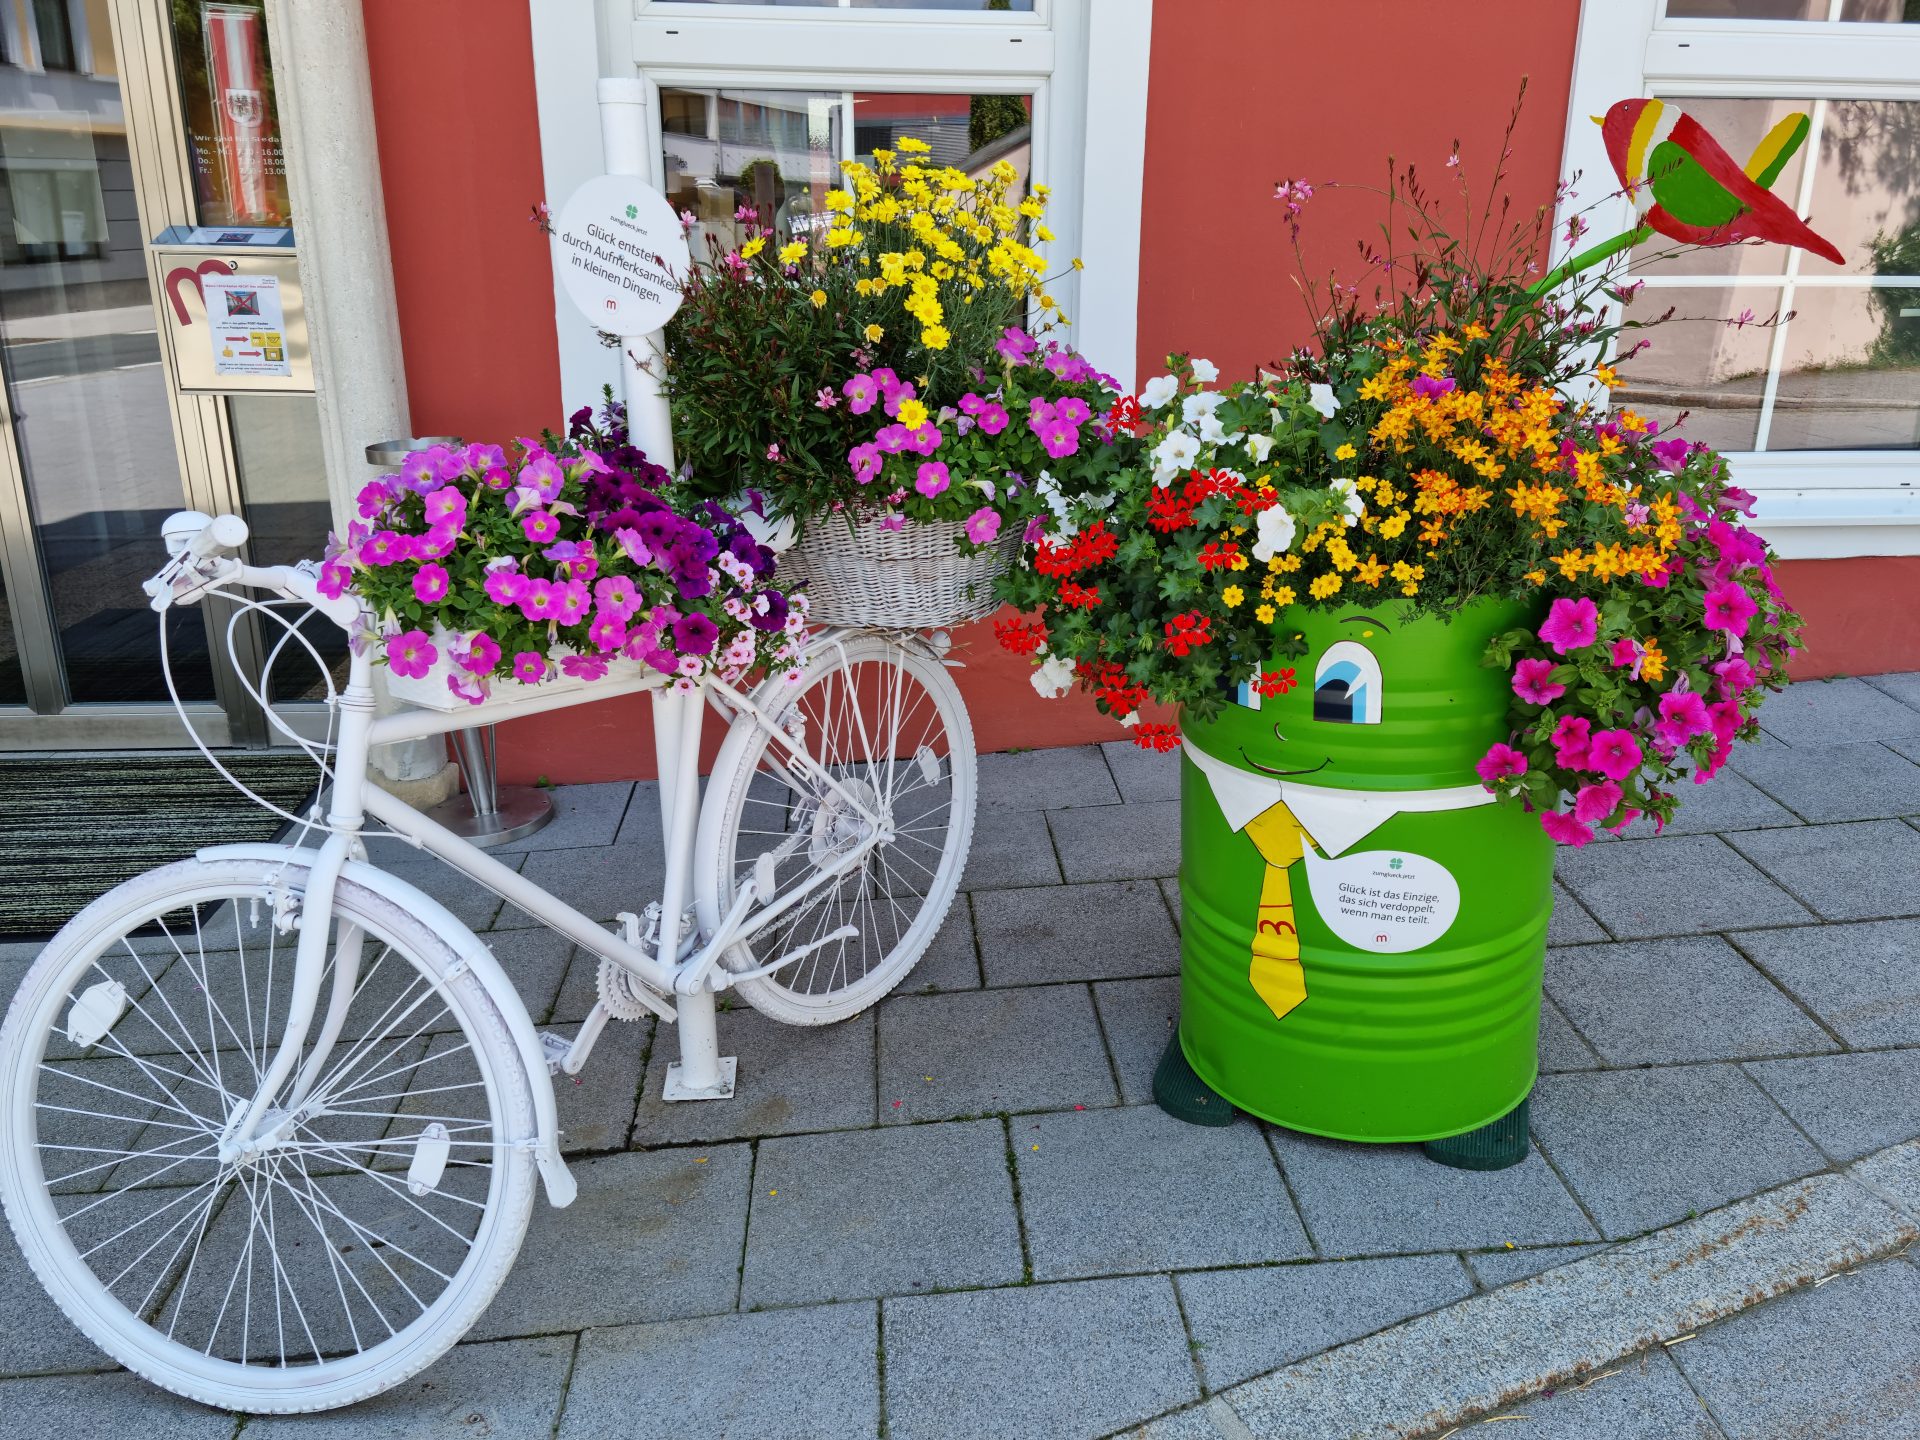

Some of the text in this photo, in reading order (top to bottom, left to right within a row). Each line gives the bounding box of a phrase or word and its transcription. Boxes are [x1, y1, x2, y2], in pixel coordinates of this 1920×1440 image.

[262, 148, 284, 156] 16.00
[263, 158, 285, 166] 18.00
[610, 215, 648, 236] zumglueck.jetzt
[587, 223, 663, 267] Glück entsteh
[562, 231, 680, 294] durch Aufmerksamkeit
[571, 252, 661, 304] in kleinen Dingen.
[1372, 870, 1415, 880] zumglueck.jetzt
[1338, 882, 1440, 904] Glück ist das Einzige,
[1338, 894, 1436, 915] das sich verdoppelt,
[1341, 906, 1430, 925] wenn man es teilt.
